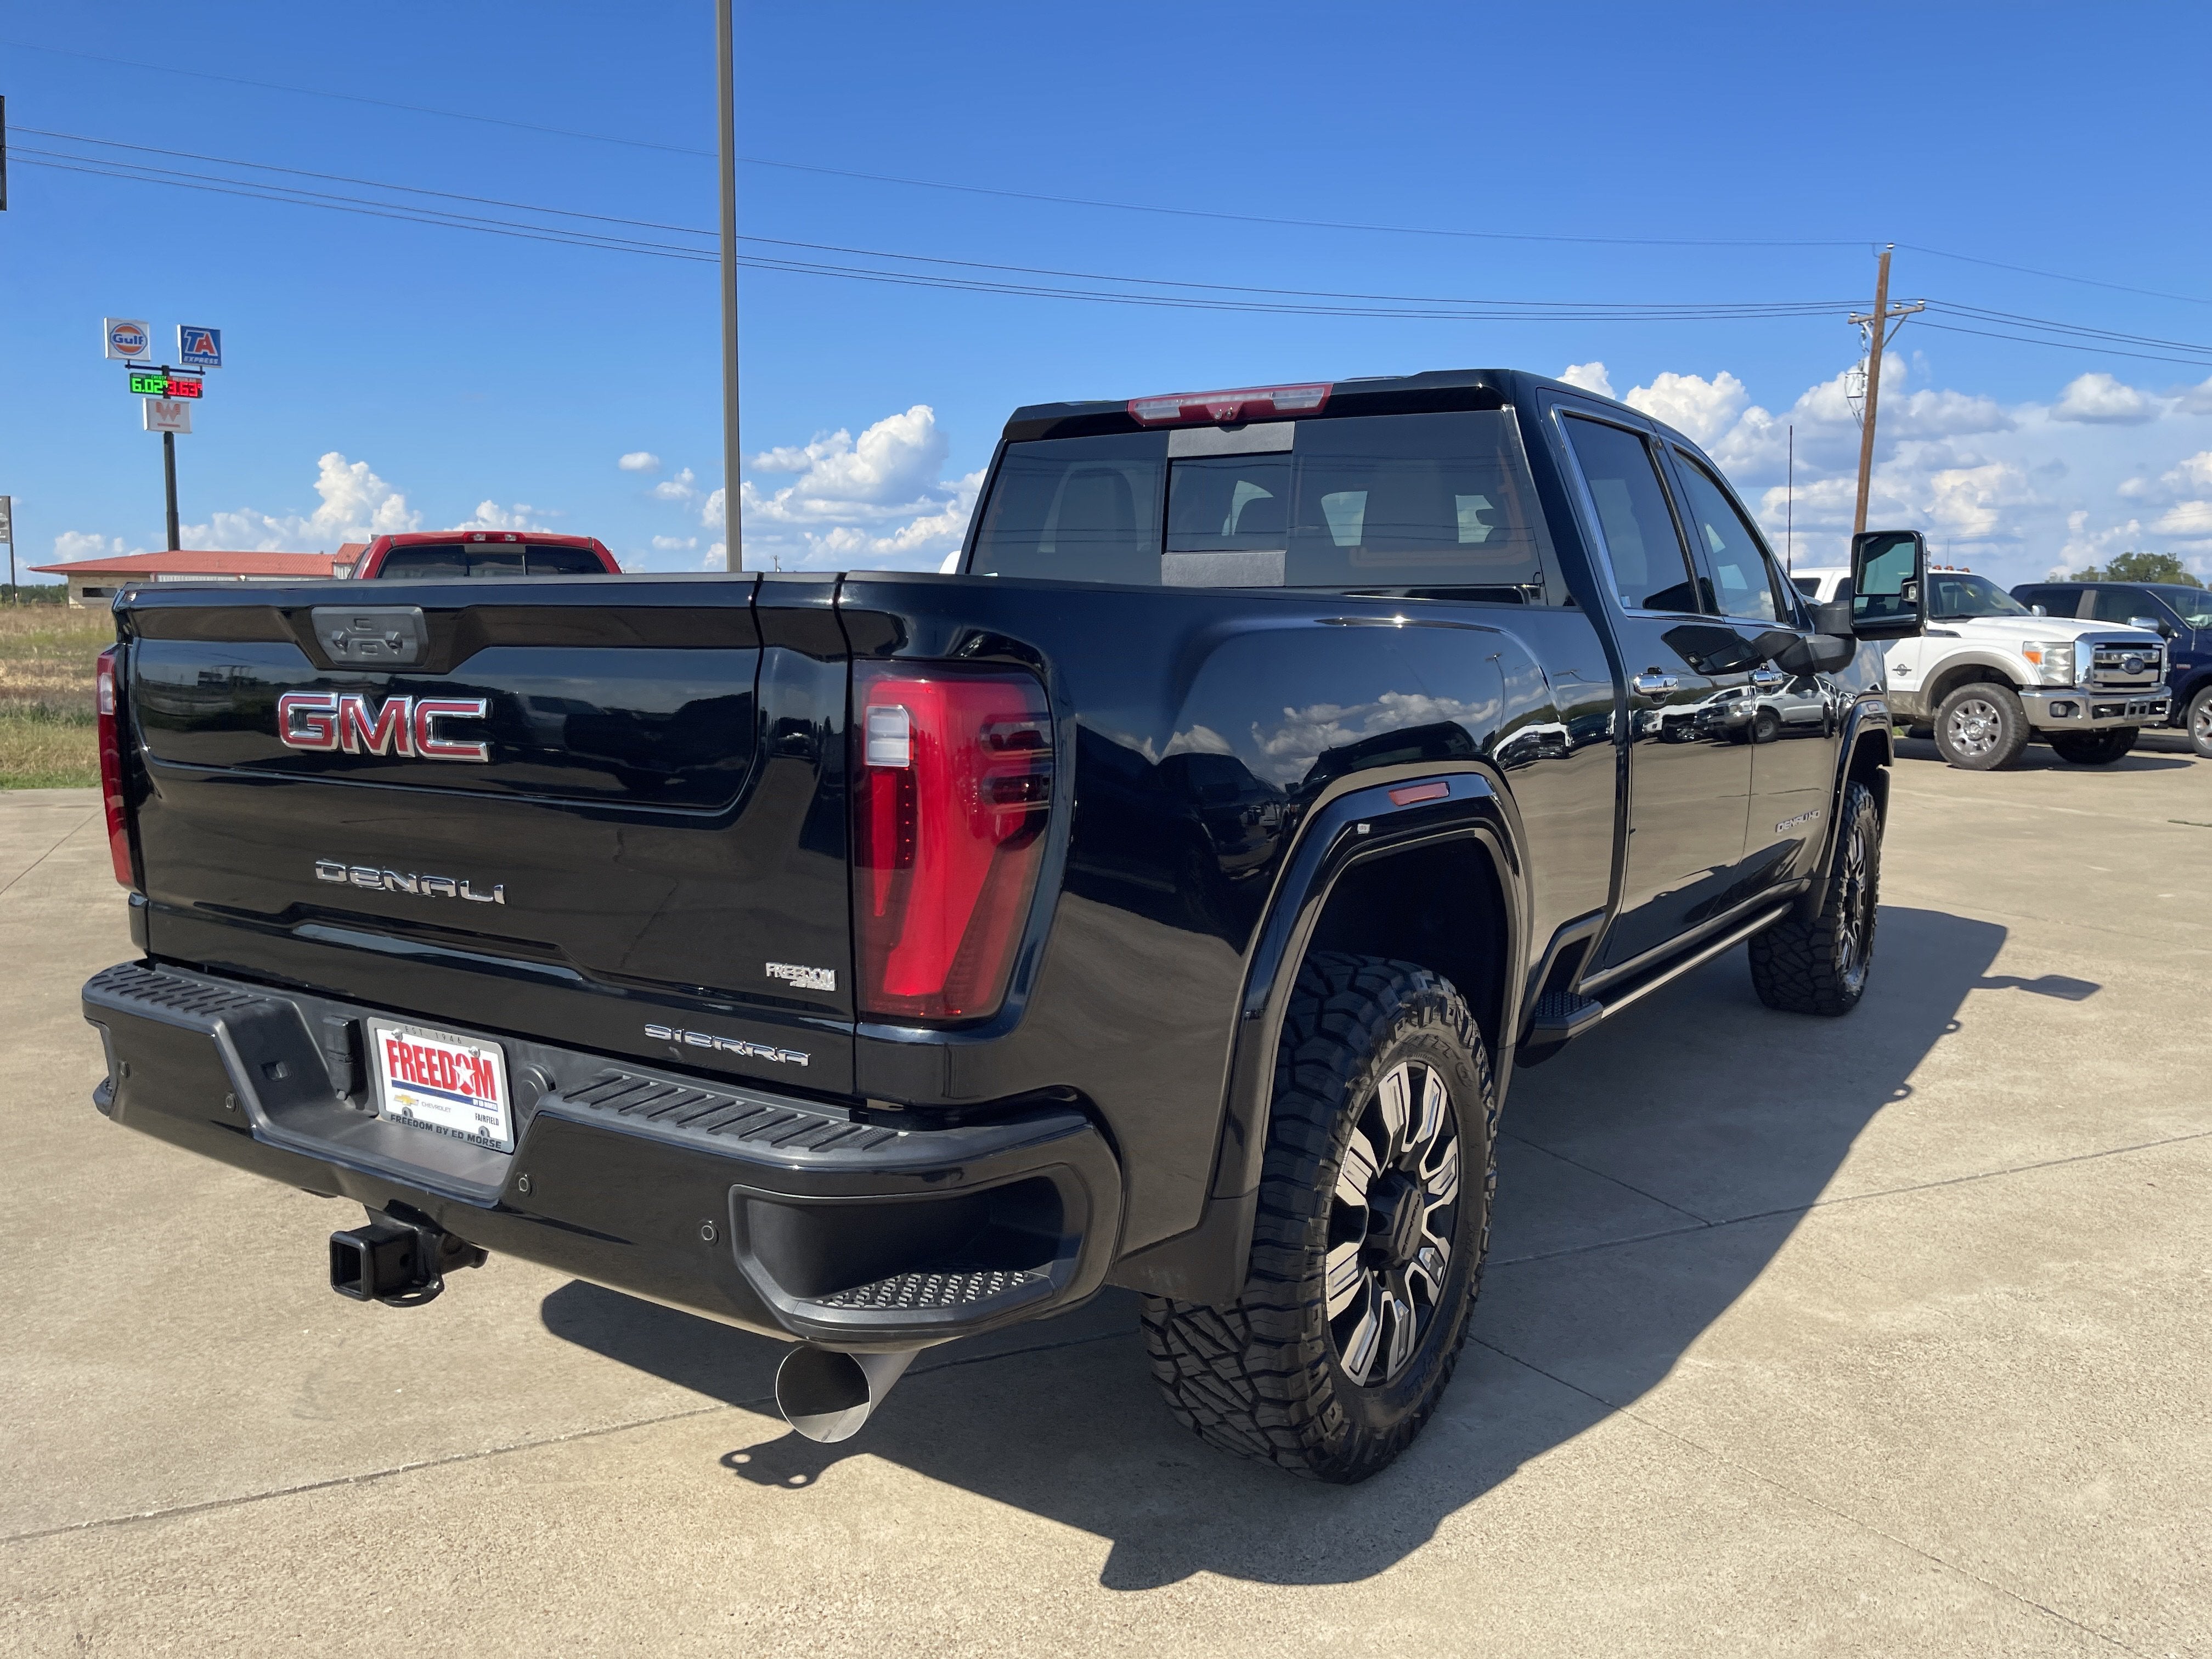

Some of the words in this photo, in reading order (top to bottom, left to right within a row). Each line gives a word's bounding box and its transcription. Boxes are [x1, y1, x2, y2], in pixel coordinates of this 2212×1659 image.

[112, 334, 144, 345] Gulf
[184, 330, 218, 356] TA
[278, 690, 492, 763] GMC
[315, 859, 505, 905] DENALI
[435, 1032, 462, 1044] 1946
[645, 1024, 811, 1067] SIERRA
[386, 1039, 497, 1101] FREEDOM
[421, 1101, 452, 1113] CHEVROLET
[475, 1113, 499, 1126] FAIRFIELD
[390, 1114, 433, 1131] FREEDOM
[436, 1125, 448, 1136] BY
[451, 1129, 464, 1139] ED
[467, 1135, 502, 1149] MORSE
